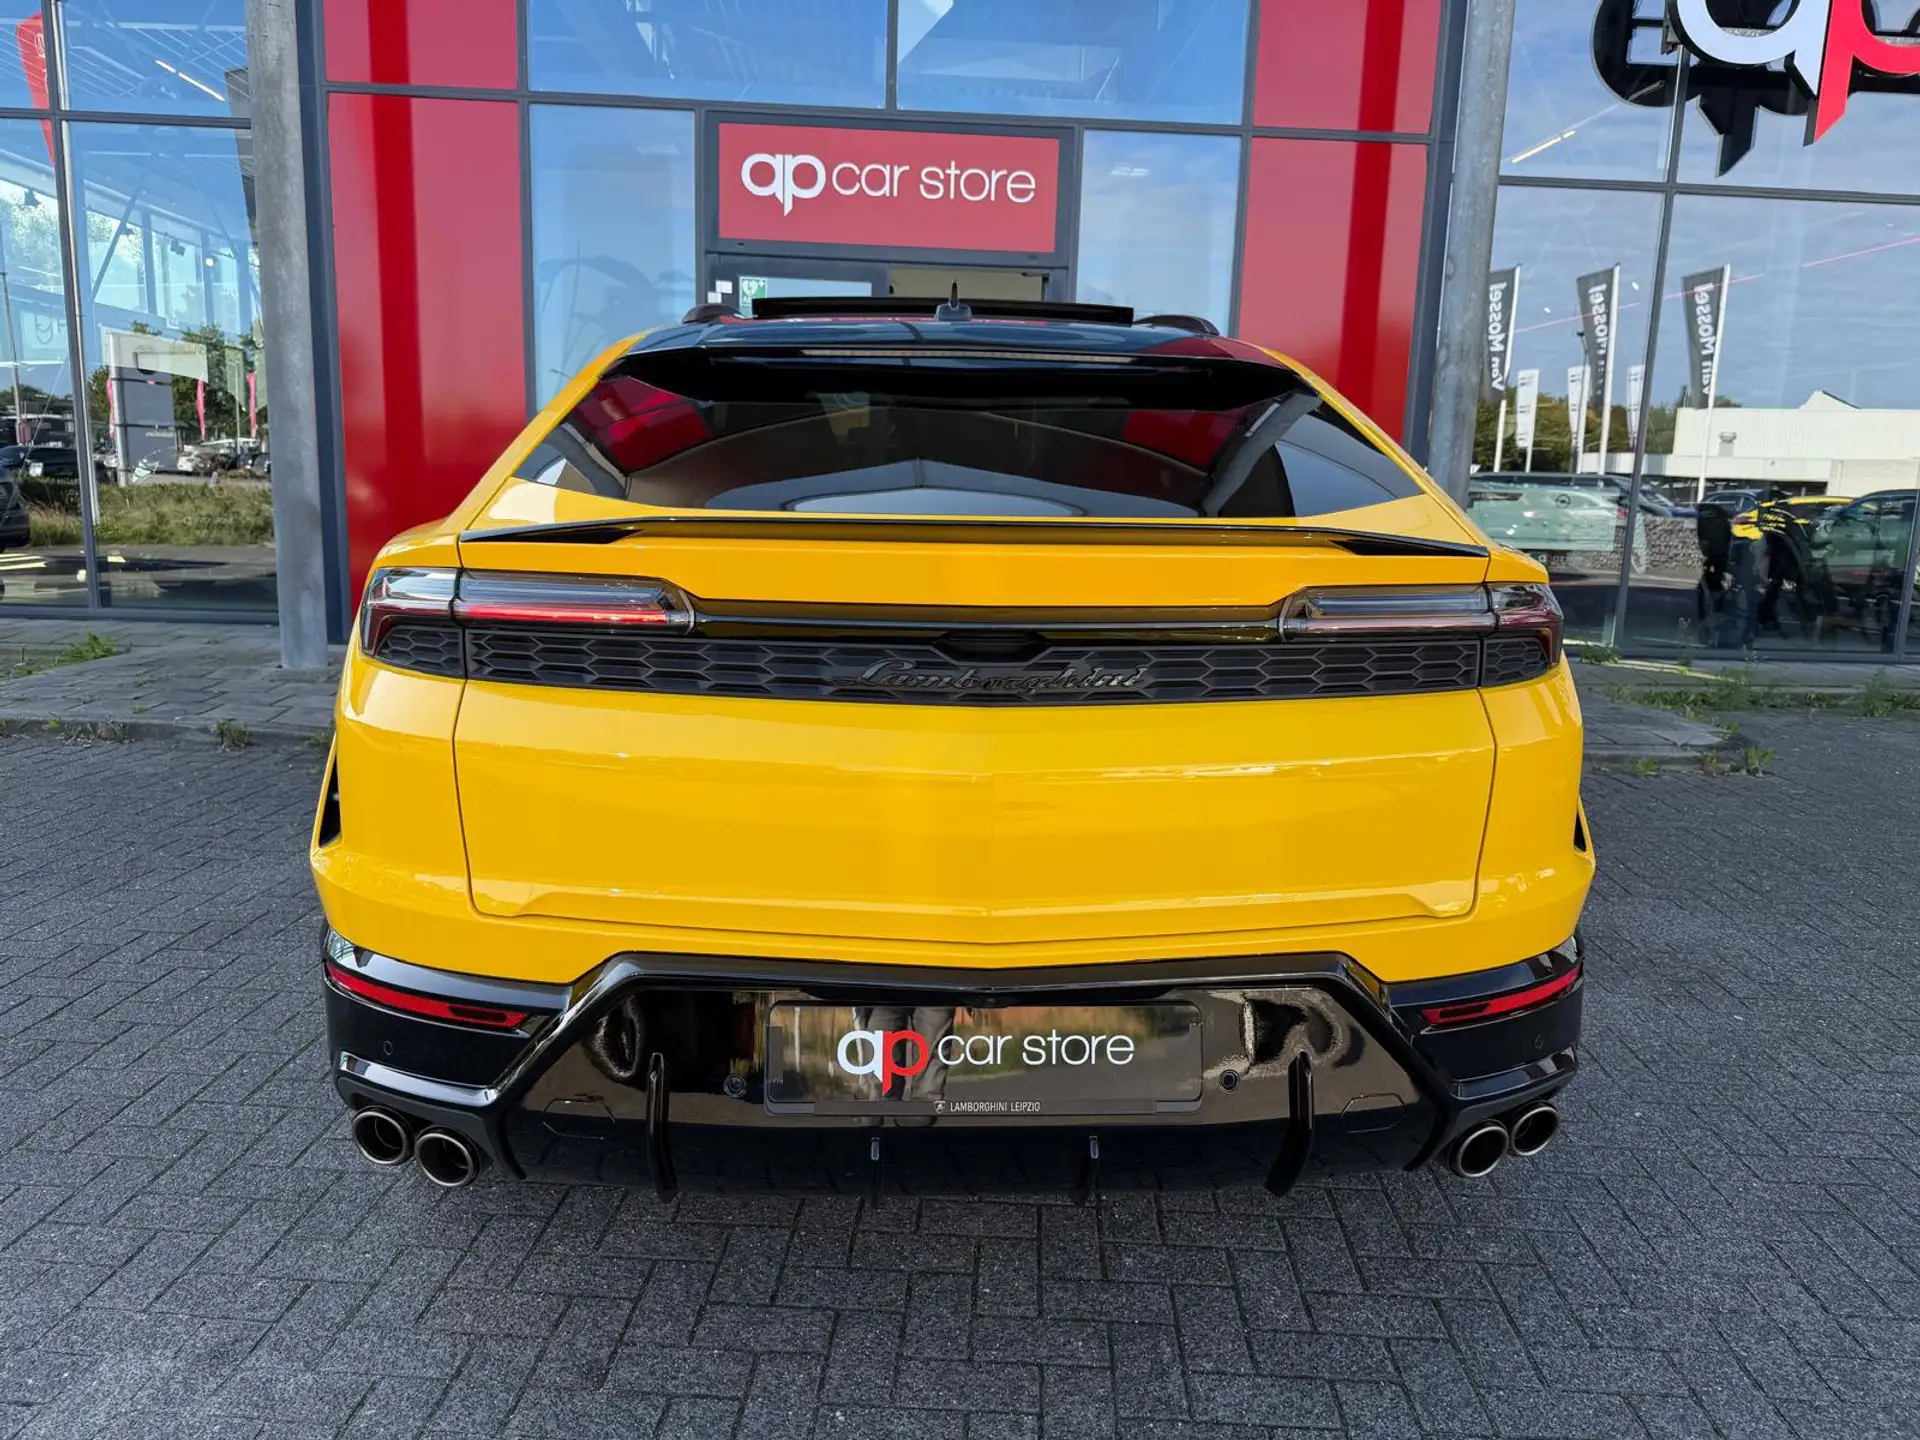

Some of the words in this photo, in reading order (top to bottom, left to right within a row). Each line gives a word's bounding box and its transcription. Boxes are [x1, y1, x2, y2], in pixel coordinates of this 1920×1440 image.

[741, 153, 826, 216] ap
[832, 162, 910, 197] car
[919, 160, 1036, 203] store
[834, 659, 1148, 697] Lamborghini
[837, 1029, 929, 1096] ap
[937, 1034, 1012, 1066] car
[1022, 1028, 1135, 1066] store
[950, 1101, 1008, 1113] LAMBORGHINI
[1010, 1101, 1041, 1113] LEIPZIG
